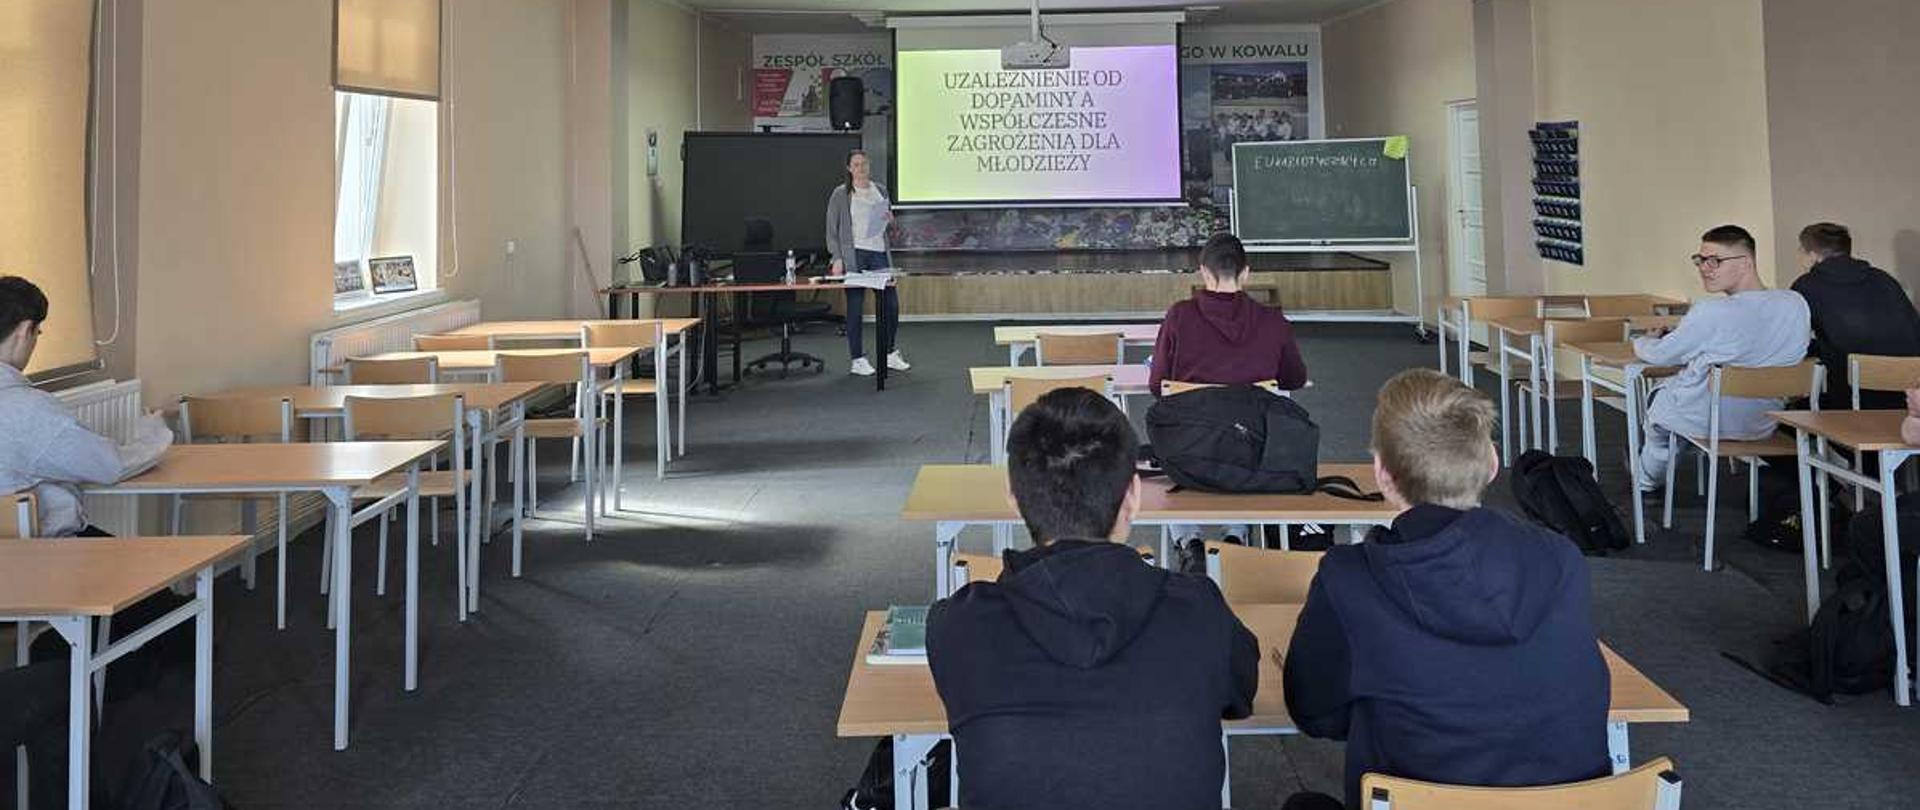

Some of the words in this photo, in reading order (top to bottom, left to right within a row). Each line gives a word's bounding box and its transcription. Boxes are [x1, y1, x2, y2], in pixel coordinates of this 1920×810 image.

[763, 51, 825, 67] ZESPÓŁ
[832, 48, 885, 65] SZKÓŁ
[1209, 46, 1226, 58] W
[1232, 44, 1308, 57] KOWALU
[1093, 70, 1122, 86] OD
[972, 91, 1076, 109] DOPAMINY
[1081, 91, 1095, 107] A
[960, 108, 1107, 130] WSPÓŁCZESNE
[1081, 132, 1121, 150] DLA
[976, 151, 1091, 172] MŁODZIEŻY
